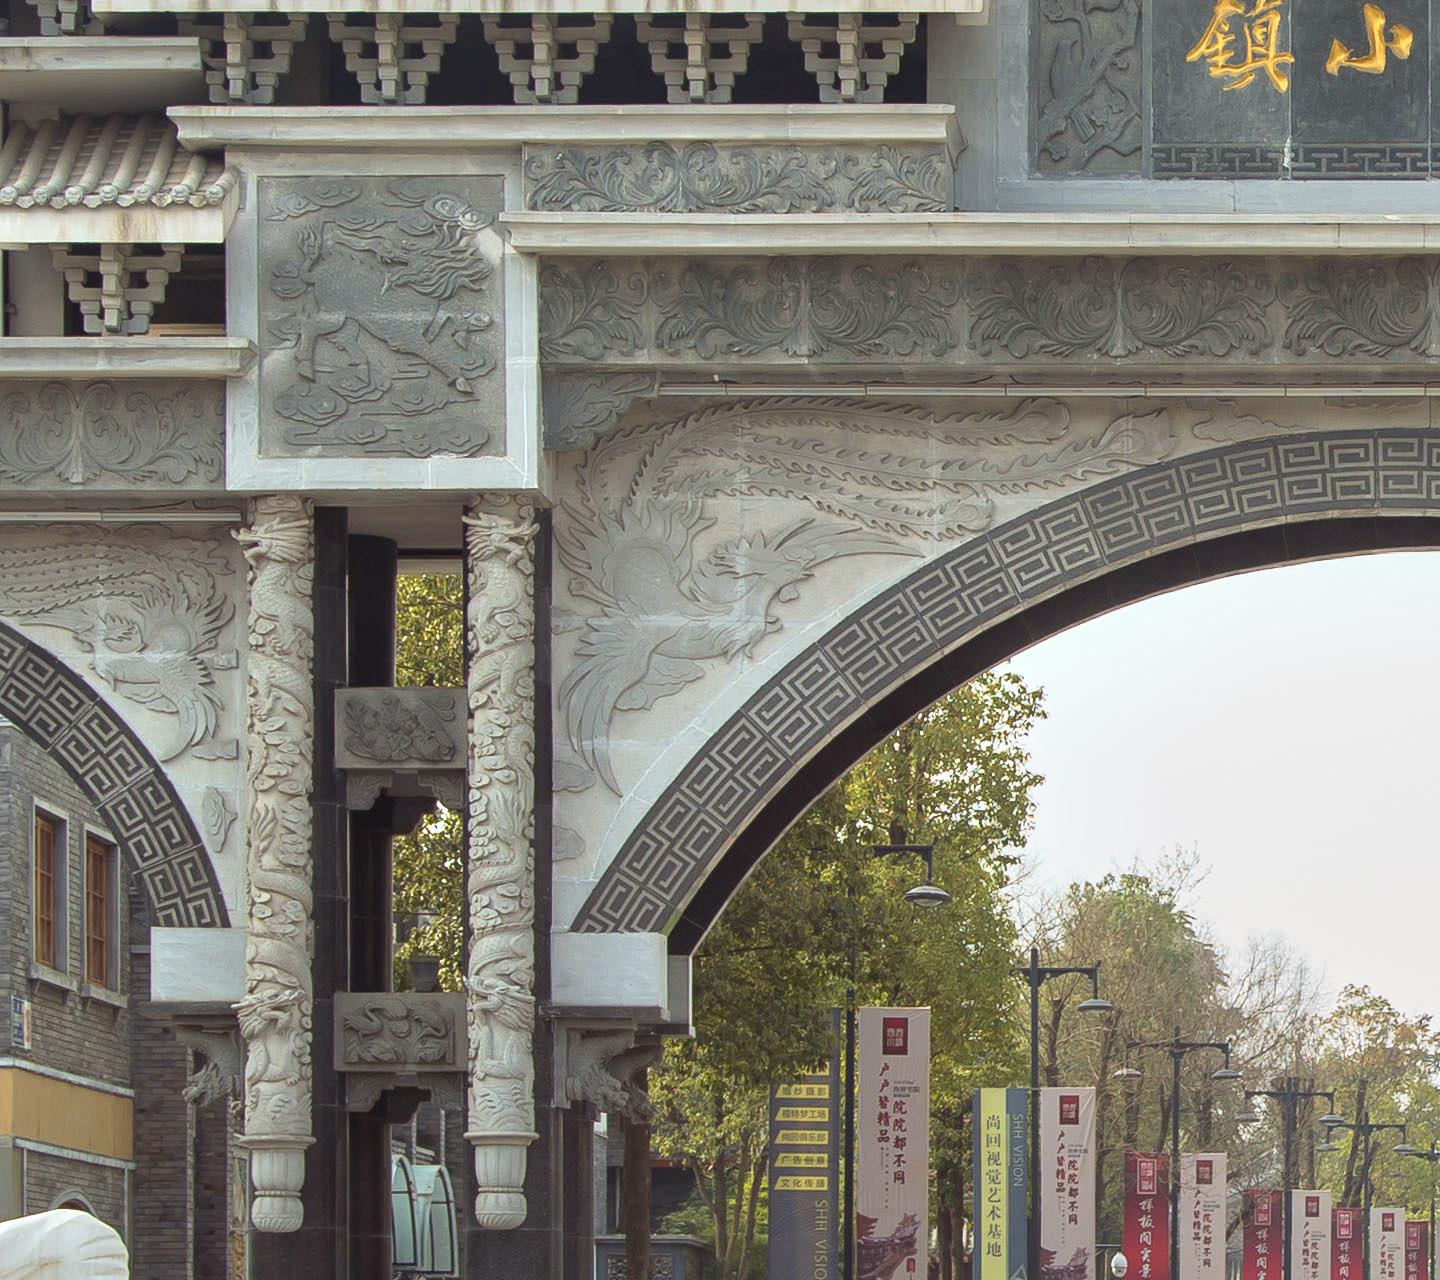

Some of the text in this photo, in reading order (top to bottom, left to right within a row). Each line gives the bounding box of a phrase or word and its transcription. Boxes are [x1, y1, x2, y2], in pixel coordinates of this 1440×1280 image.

[780, 1155, 825, 1165] 广告创意
[892, 1099, 908, 1185] 院院都不同
[1013, 1114, 1024, 1187] SHH VISION
[780, 1177, 825, 1188] 文化传播
[986, 1114, 1002, 1258] 尚回视觉艺术基地
[815, 1199, 828, 1231] SHH
